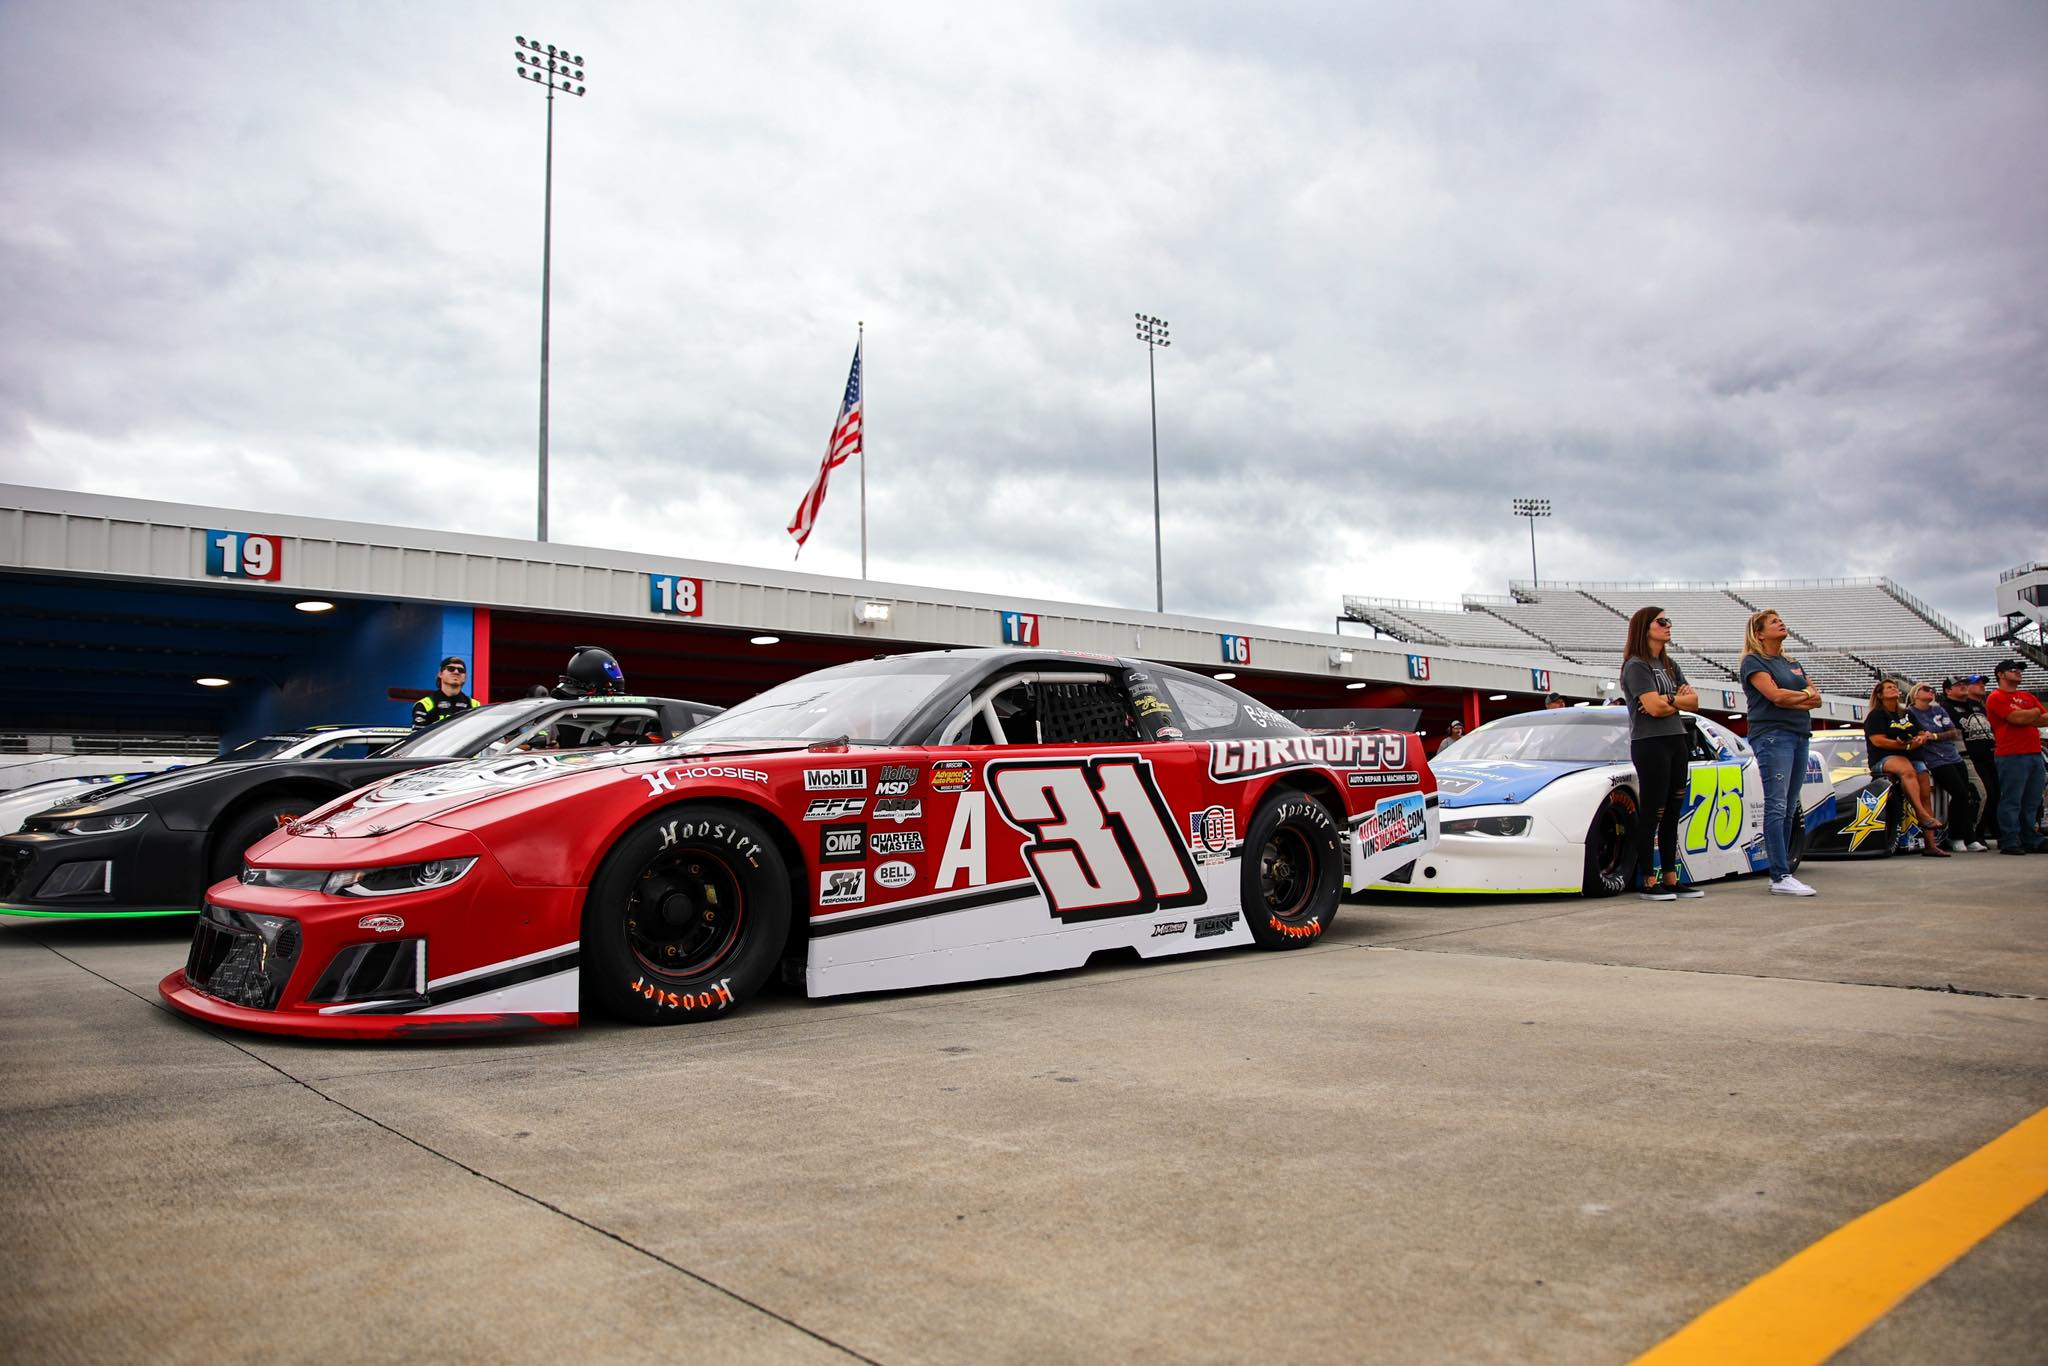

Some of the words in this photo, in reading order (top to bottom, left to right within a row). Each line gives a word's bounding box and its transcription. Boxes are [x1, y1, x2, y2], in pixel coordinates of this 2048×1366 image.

[216, 534, 273, 576] 19
[657, 577, 697, 613] 18
[1007, 614, 1034, 643] 17
[1226, 636, 1247, 662] 16
[1411, 656, 1427, 678] 15
[1535, 671, 1548, 690] 14
[1213, 734, 1403, 776] CARICOFE'S
[675, 767, 769, 784] HOOSIER
[808, 770, 848, 786] Mobil
[851, 770, 864, 784] 1
[880, 765, 919, 786] Holley
[1350, 775, 1364, 783] AUTO
[1365, 775, 1381, 783] REPAIR
[1387, 774, 1405, 782] MACHINE
[1406, 774, 1418, 782] SHOP
[875, 782, 909, 795] MSD
[807, 799, 866, 813] PFC
[875, 799, 920, 812] ARP
[1277, 803, 1330, 829] Hoosier
[1685, 764, 1743, 855] 75
[659, 820, 761, 858] Hoosier
[826, 834, 861, 851] OMP
[872, 832, 919, 848] QUARTER
[880, 841, 923, 853] MASTER
[934, 792, 987, 889] A
[991, 757, 1206, 921] 31
[881, 866, 912, 879] BELL
[822, 896, 863, 905] PERFORMANCE
[1270, 915, 1322, 939] Hoosier
[631, 977, 732, 1010] Hoosier
